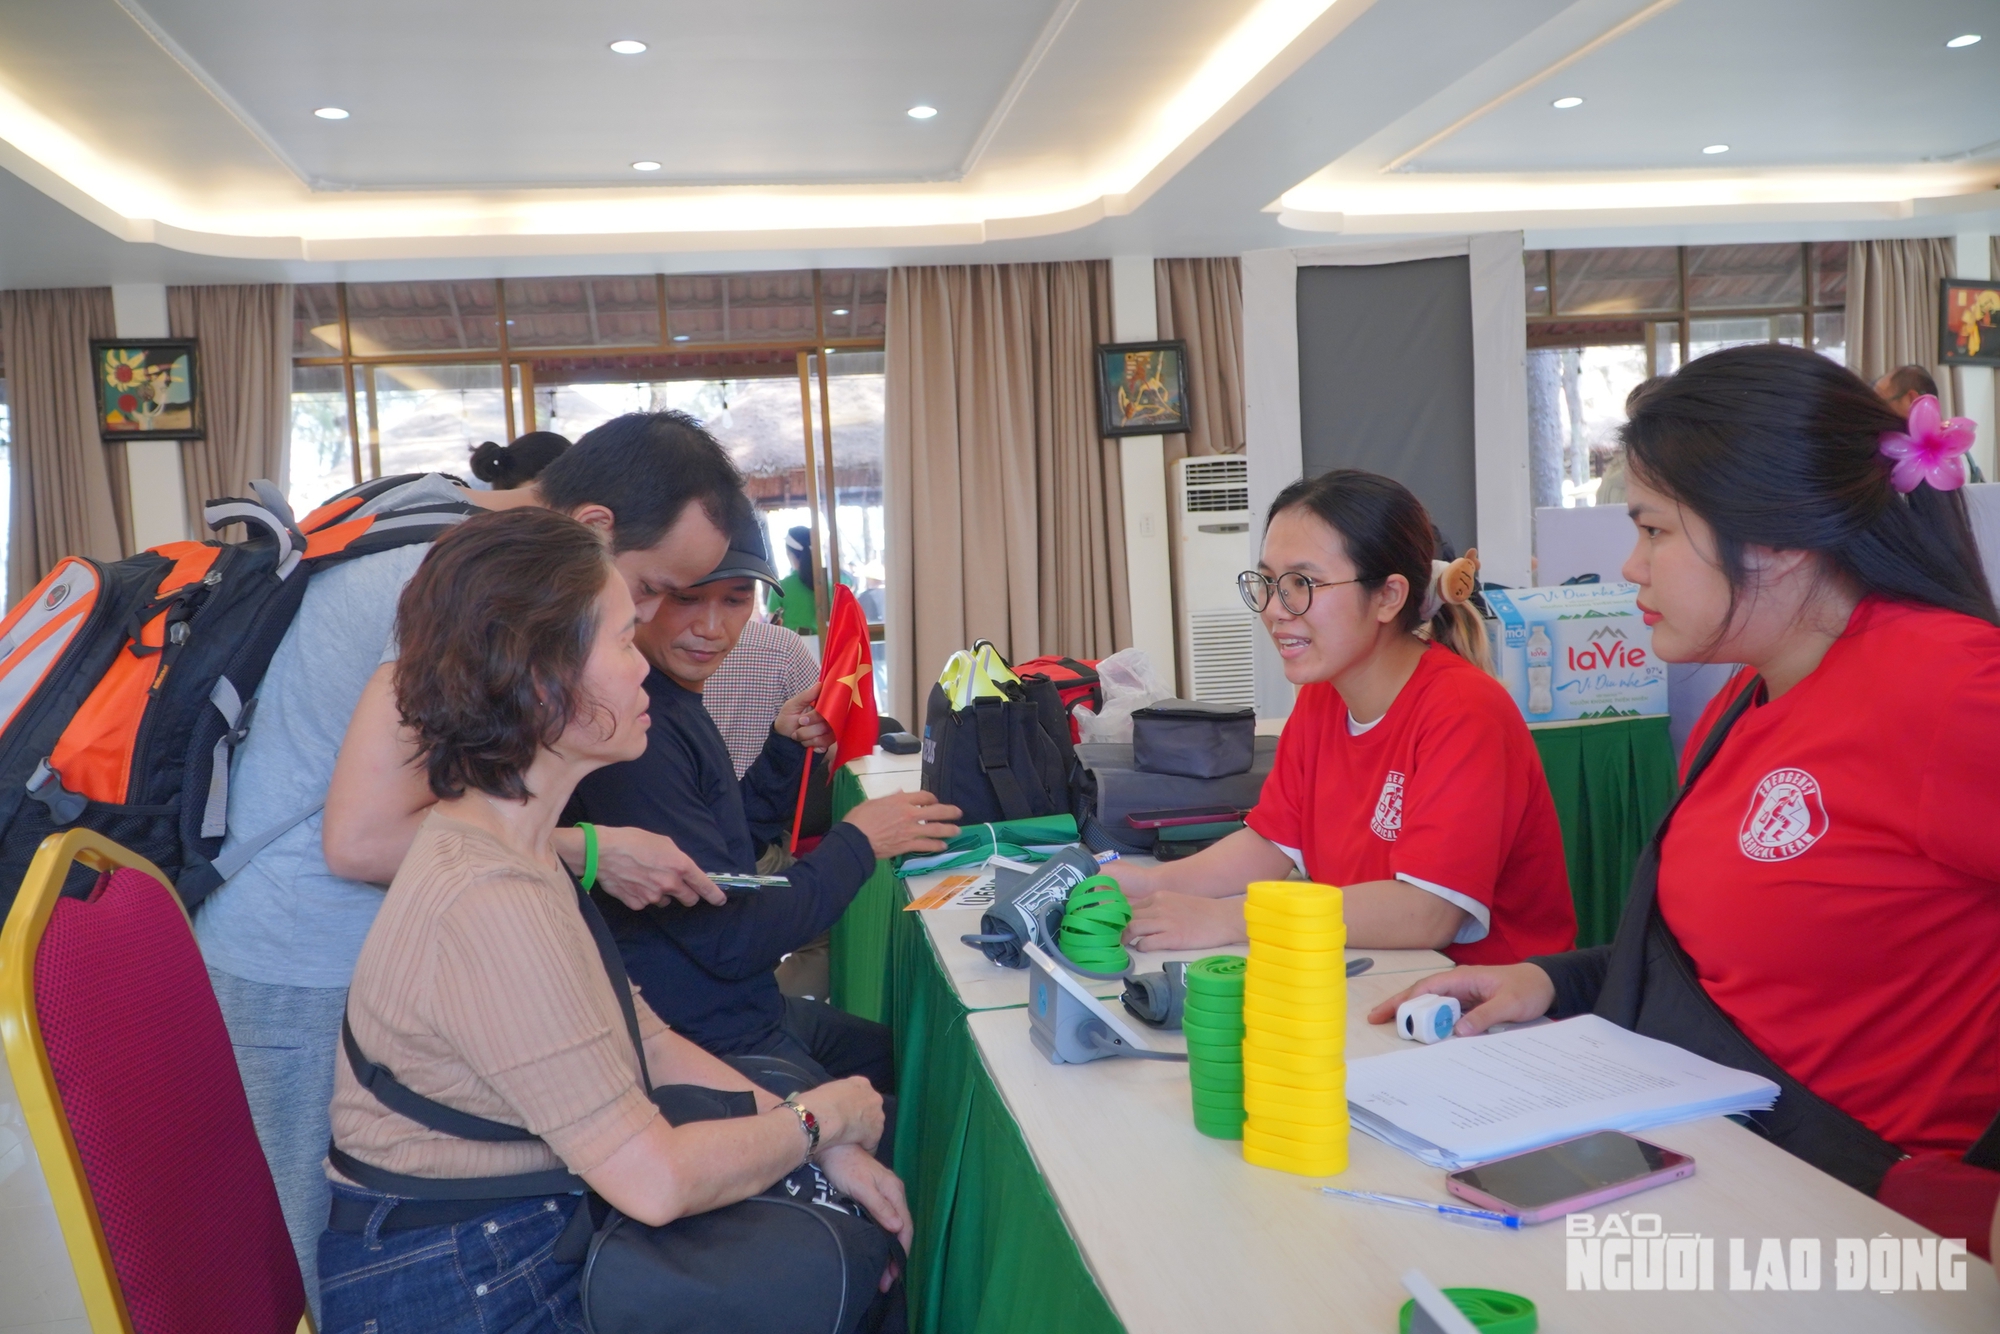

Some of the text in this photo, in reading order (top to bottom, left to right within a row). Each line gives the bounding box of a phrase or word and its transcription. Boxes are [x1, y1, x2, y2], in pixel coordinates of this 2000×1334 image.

[1568, 640, 1646, 671] laVie
[1759, 772, 1816, 798] EMERGENCY
[1742, 831, 1815, 858] MEDICAL TEAM
